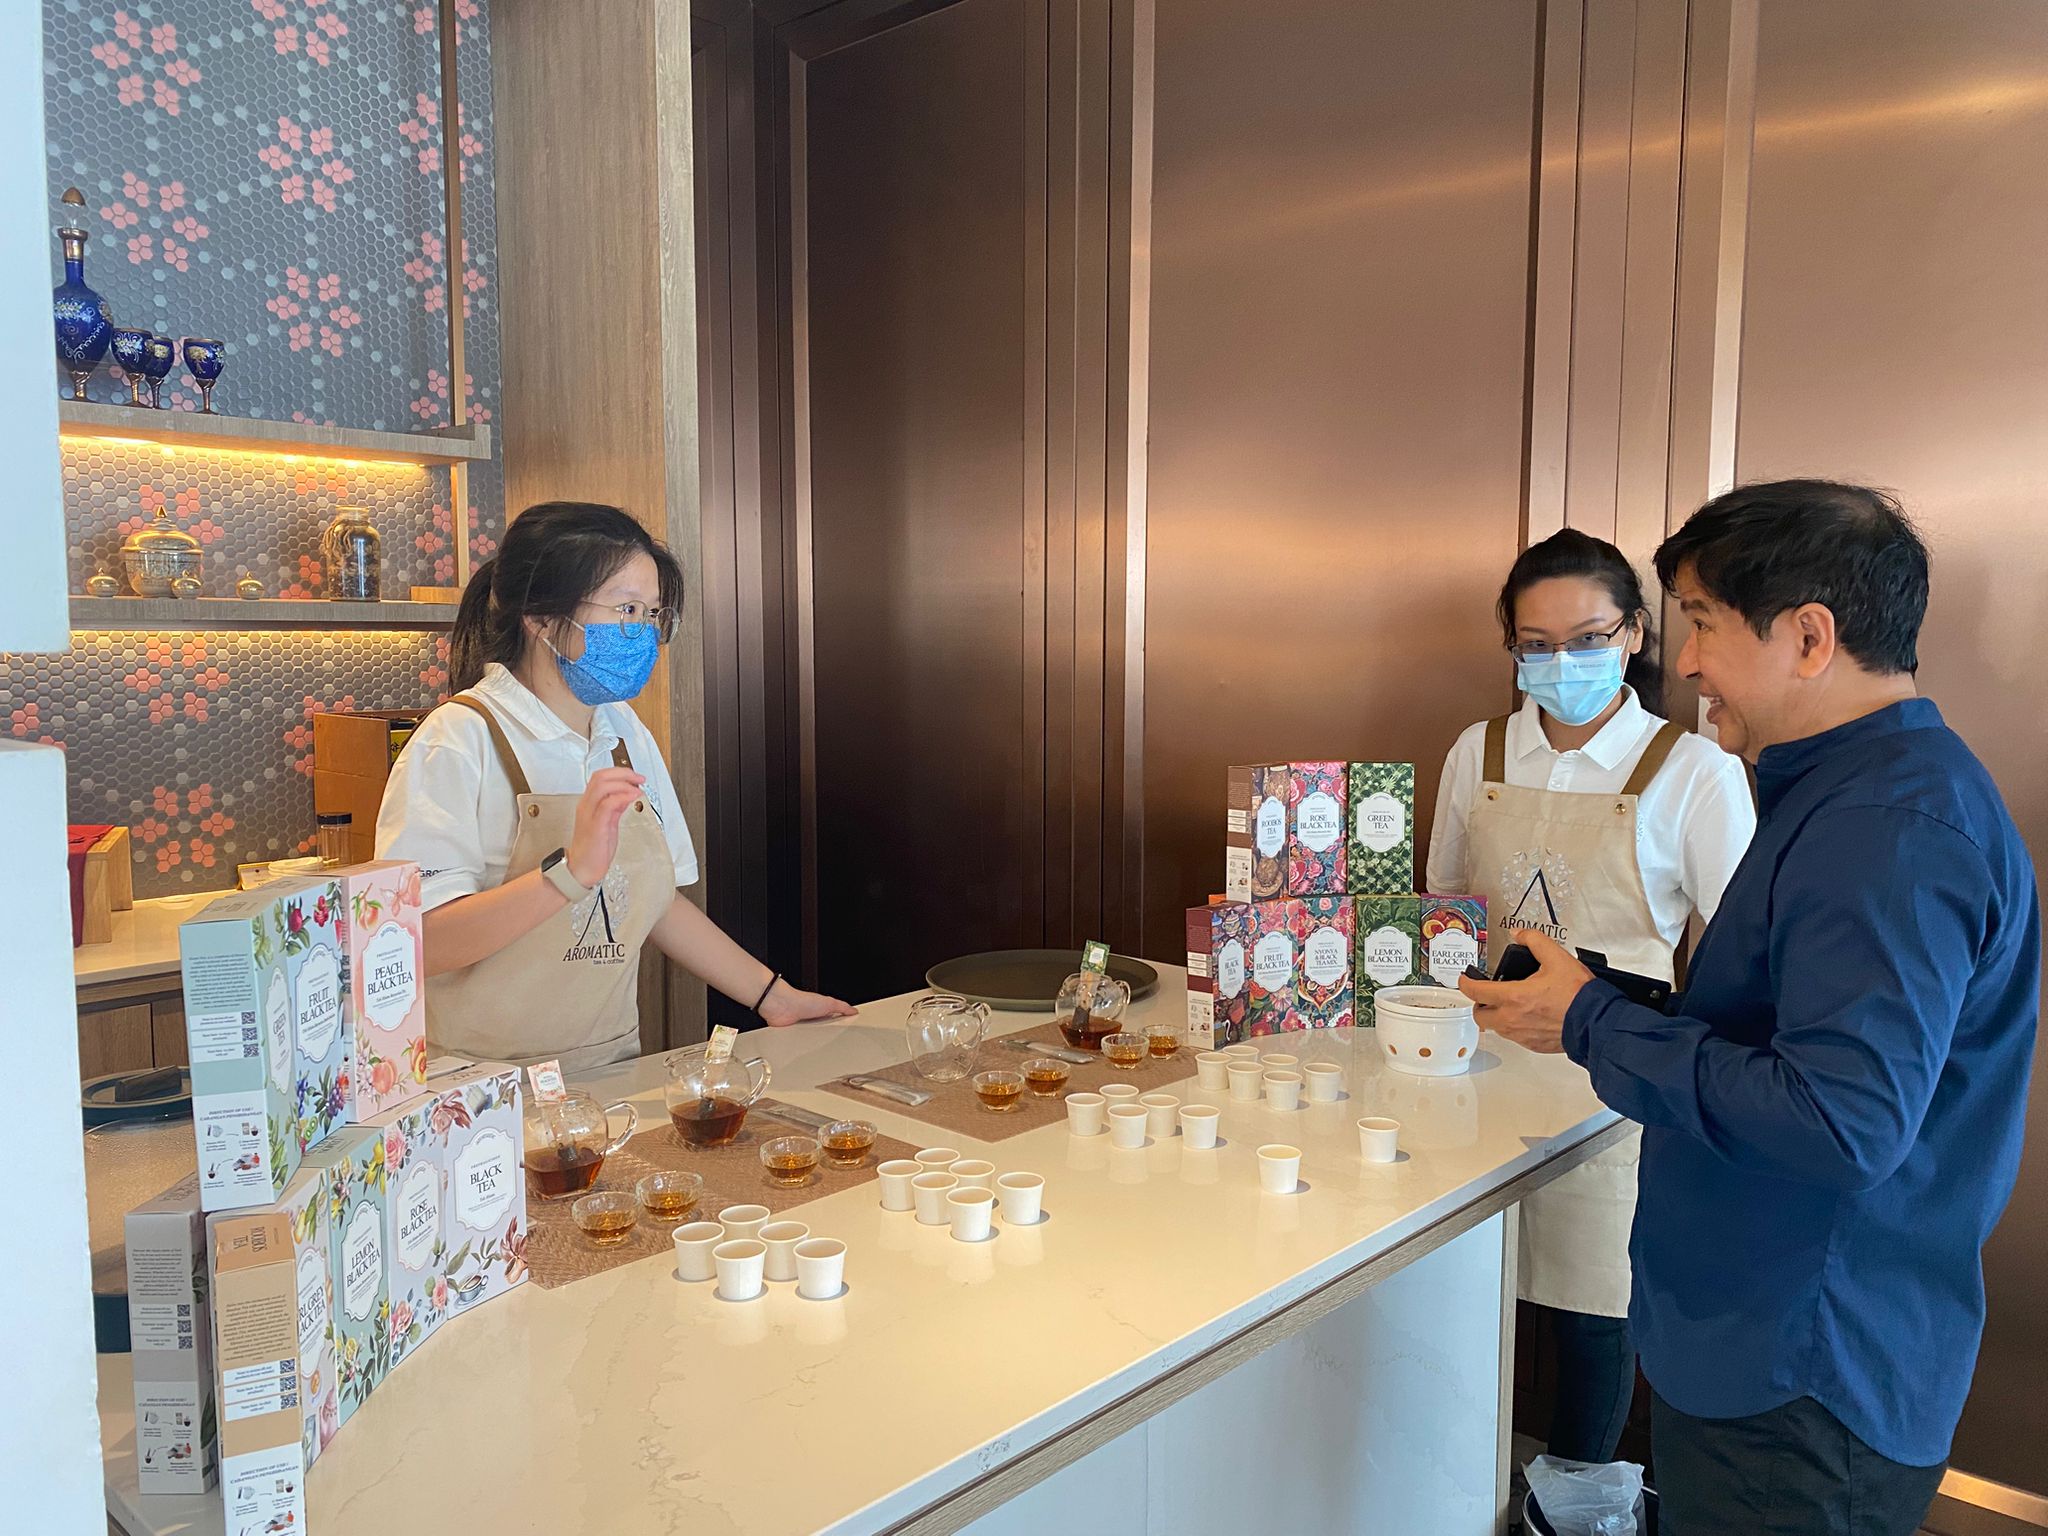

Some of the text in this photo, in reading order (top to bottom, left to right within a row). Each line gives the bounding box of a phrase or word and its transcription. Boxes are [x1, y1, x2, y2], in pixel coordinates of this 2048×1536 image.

[1300, 821, 1337, 830] BLACK TEA
[1309, 814, 1328, 822] ROSE
[1373, 822, 1389, 830] TEA
[1267, 827, 1276, 835] TEA
[562, 944, 625, 961] AROMATIC
[1264, 953, 1283, 962] FRUIT
[1452, 951, 1476, 959] GREY
[375, 961, 403, 980] PEACH
[1256, 960, 1290, 970] BLACK TEA
[1460, 958, 1476, 966] TEA
[368, 971, 413, 995] BLACK TEA
[308, 986, 329, 1008] FRUIT
[300, 1004, 325, 1025] BLACK
[324, 997, 337, 1012] TEA
[470, 1163, 502, 1185] BLACK
[476, 1179, 496, 1194] TEA
[410, 1198, 428, 1221] ROSE
[401, 1214, 424, 1240] BLACK
[425, 1205, 437, 1222] TEA
[233, 1235, 248, 1250] TEA
[352, 1238, 374, 1269] LEMON
[347, 1259, 369, 1288] BLACK
[369, 1247, 381, 1267] TEA
[313, 1298, 326, 1320] TEA
